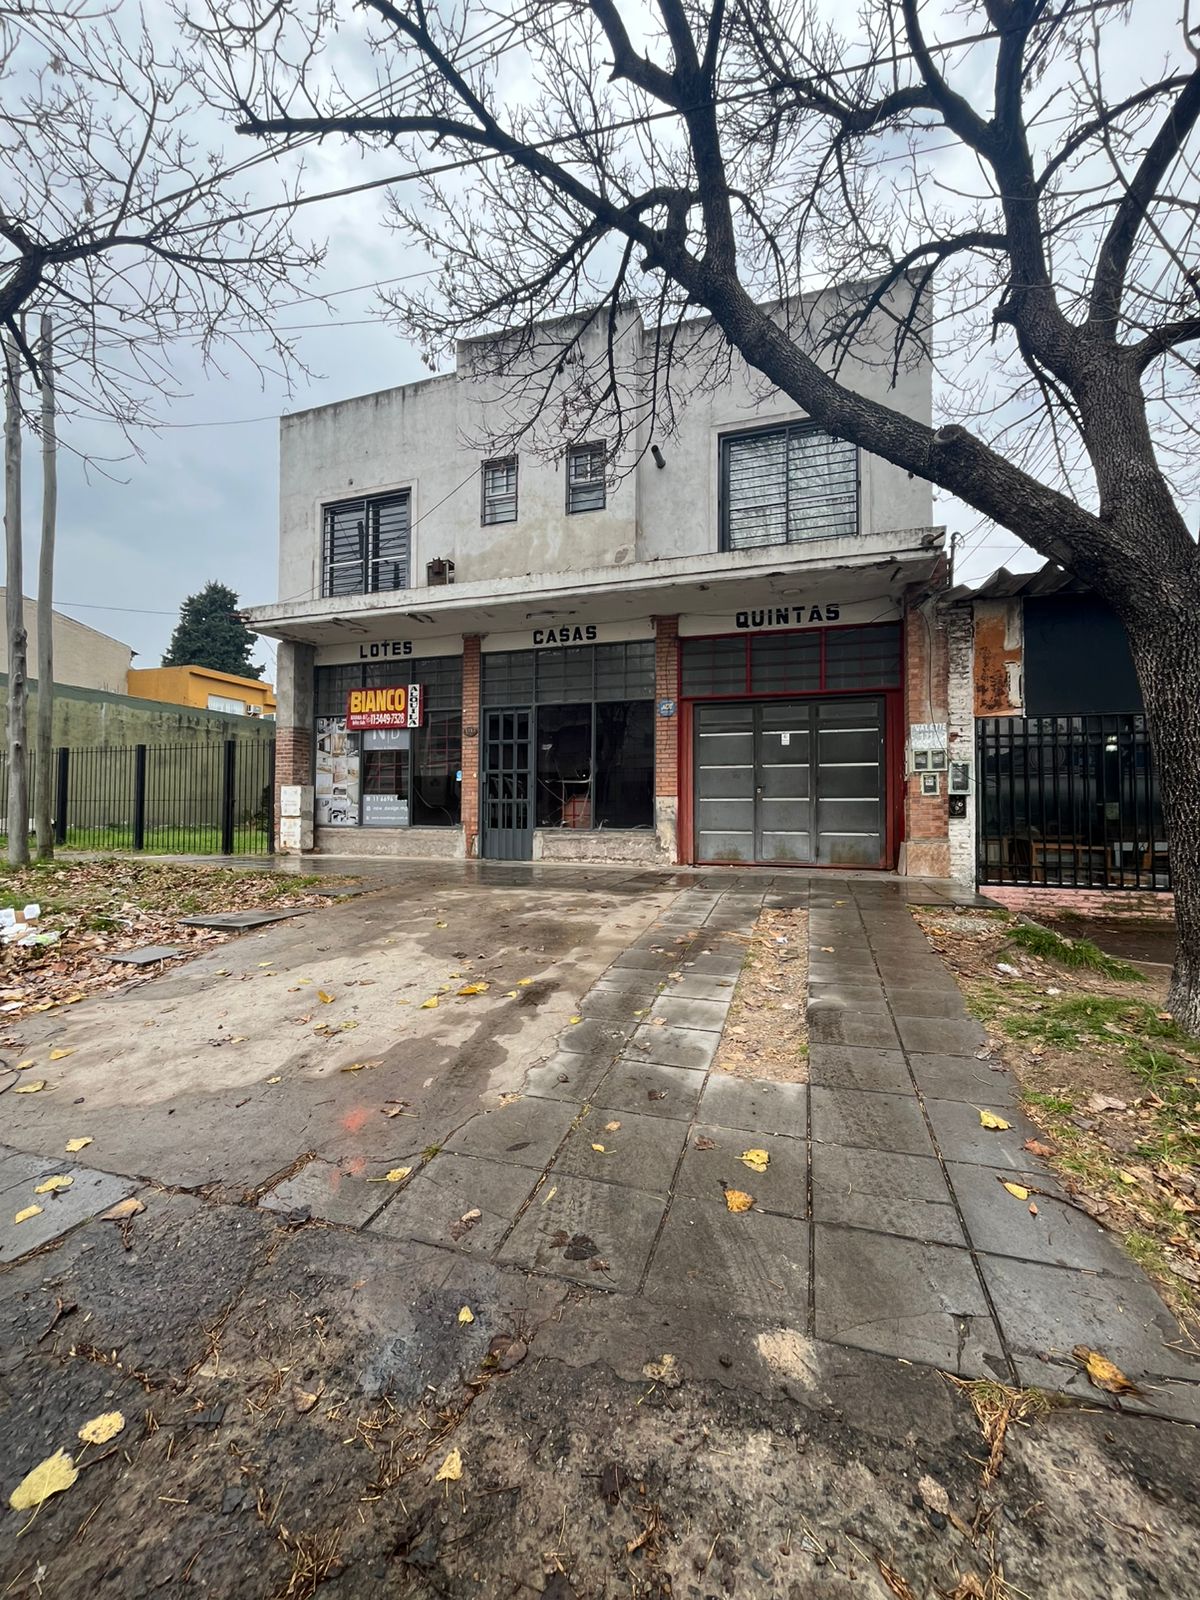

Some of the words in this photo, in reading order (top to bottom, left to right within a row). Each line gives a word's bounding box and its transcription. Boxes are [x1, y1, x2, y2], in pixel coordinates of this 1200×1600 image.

[736, 603, 839, 628] QUINTAS
[533, 625, 597, 644] CASAS
[360, 640, 412, 658] LOTES
[351, 688, 405, 713] BIANCO
